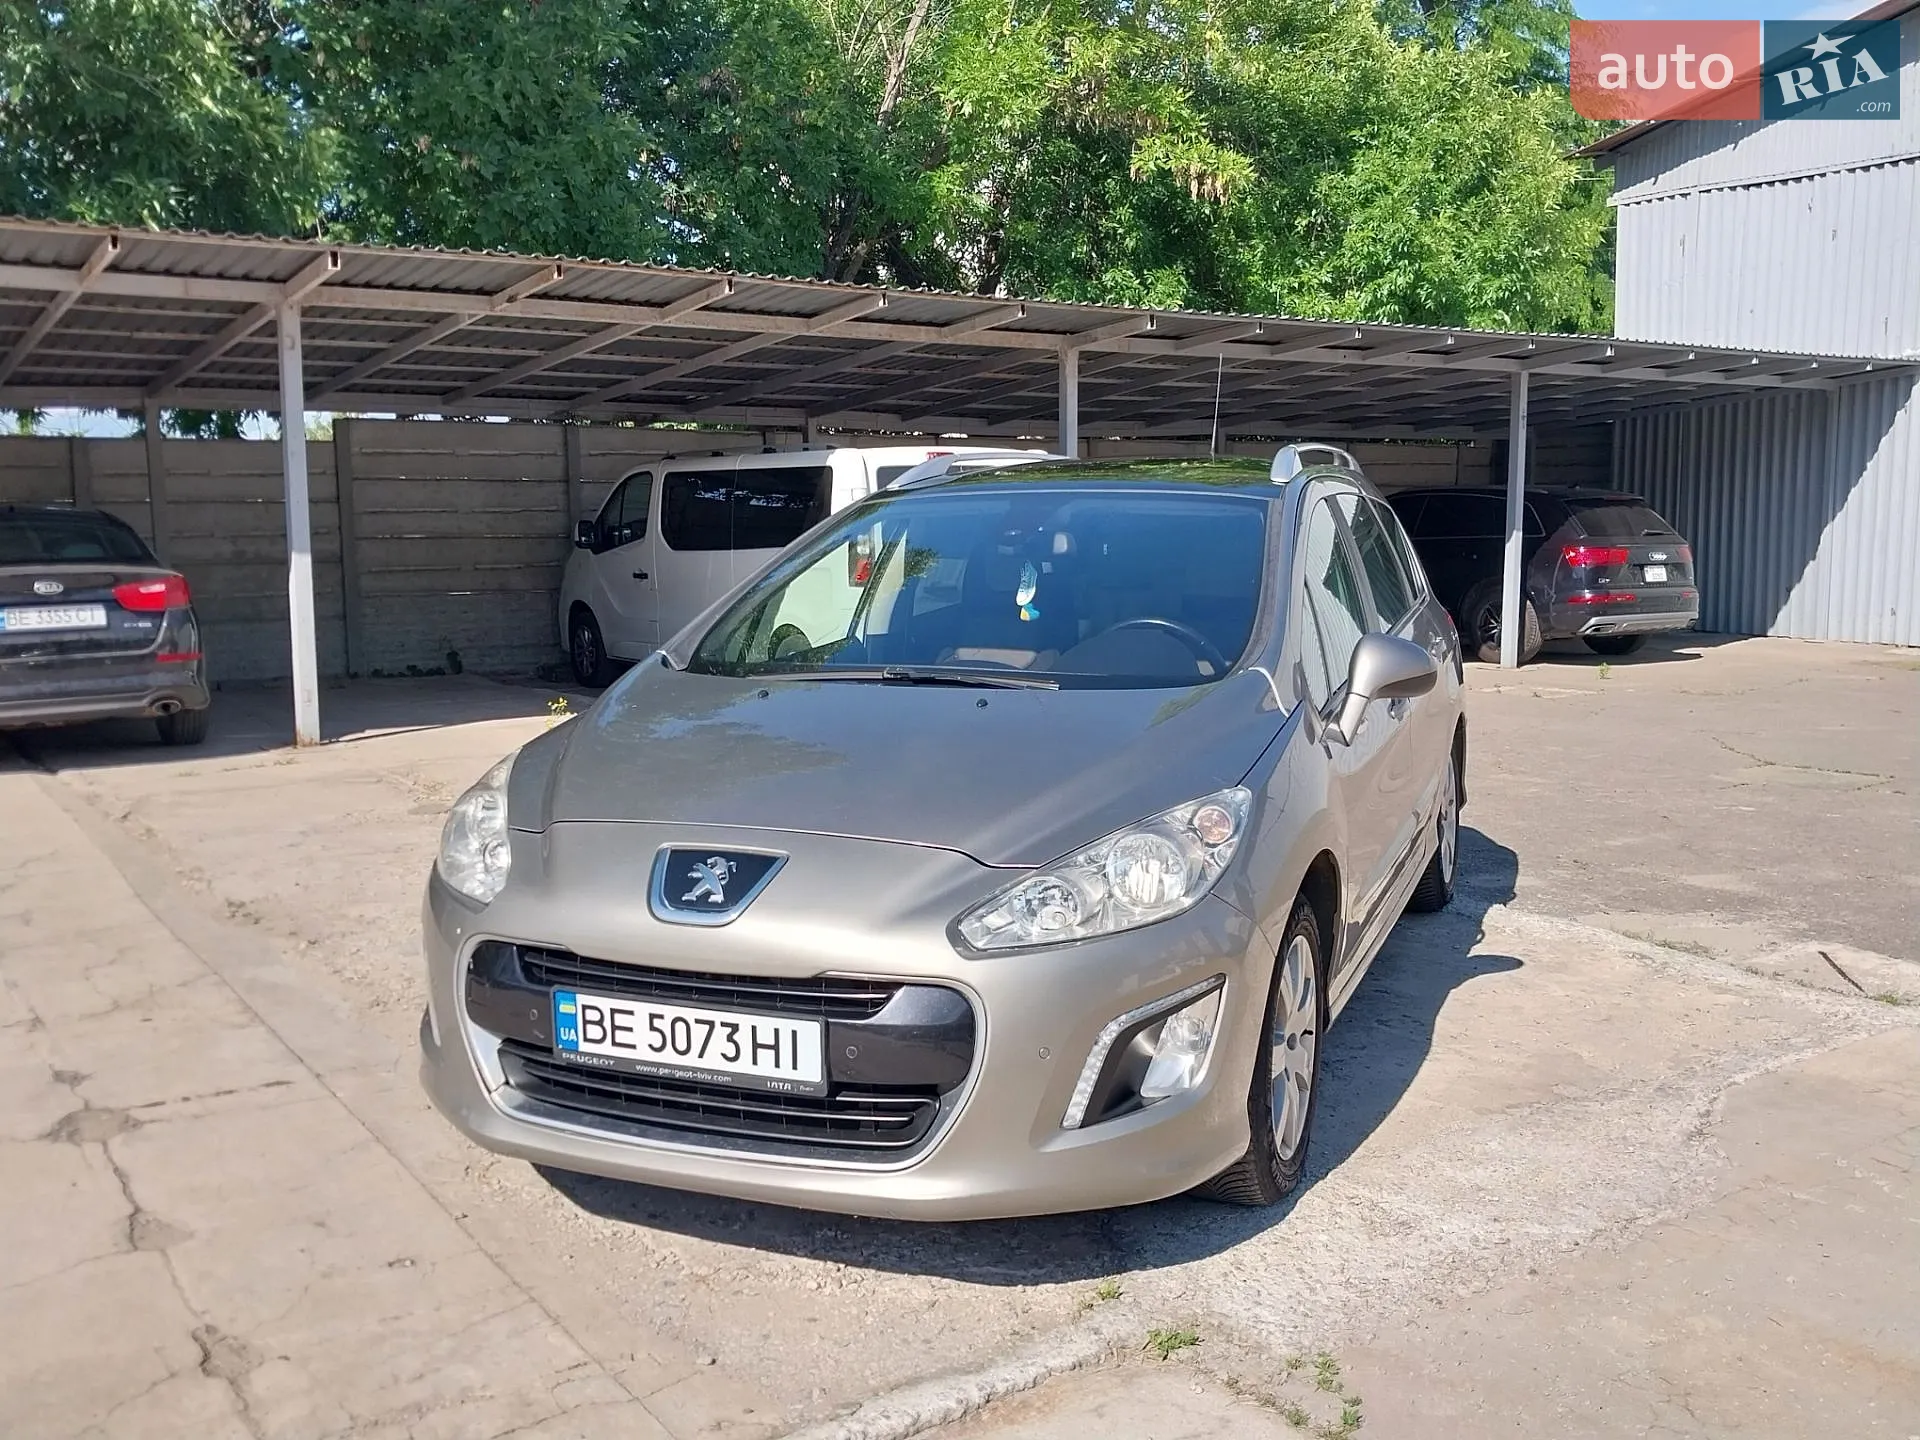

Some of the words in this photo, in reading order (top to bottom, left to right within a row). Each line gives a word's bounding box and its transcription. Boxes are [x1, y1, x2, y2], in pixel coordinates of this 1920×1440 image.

[7, 608, 32, 626] BE
[560, 1028, 578, 1042] UA
[581, 1004, 637, 1050] BE
[648, 1012, 741, 1063] 5073
[751, 1024, 798, 1071] HI
[562, 1052, 616, 1066] PEUGEOT
